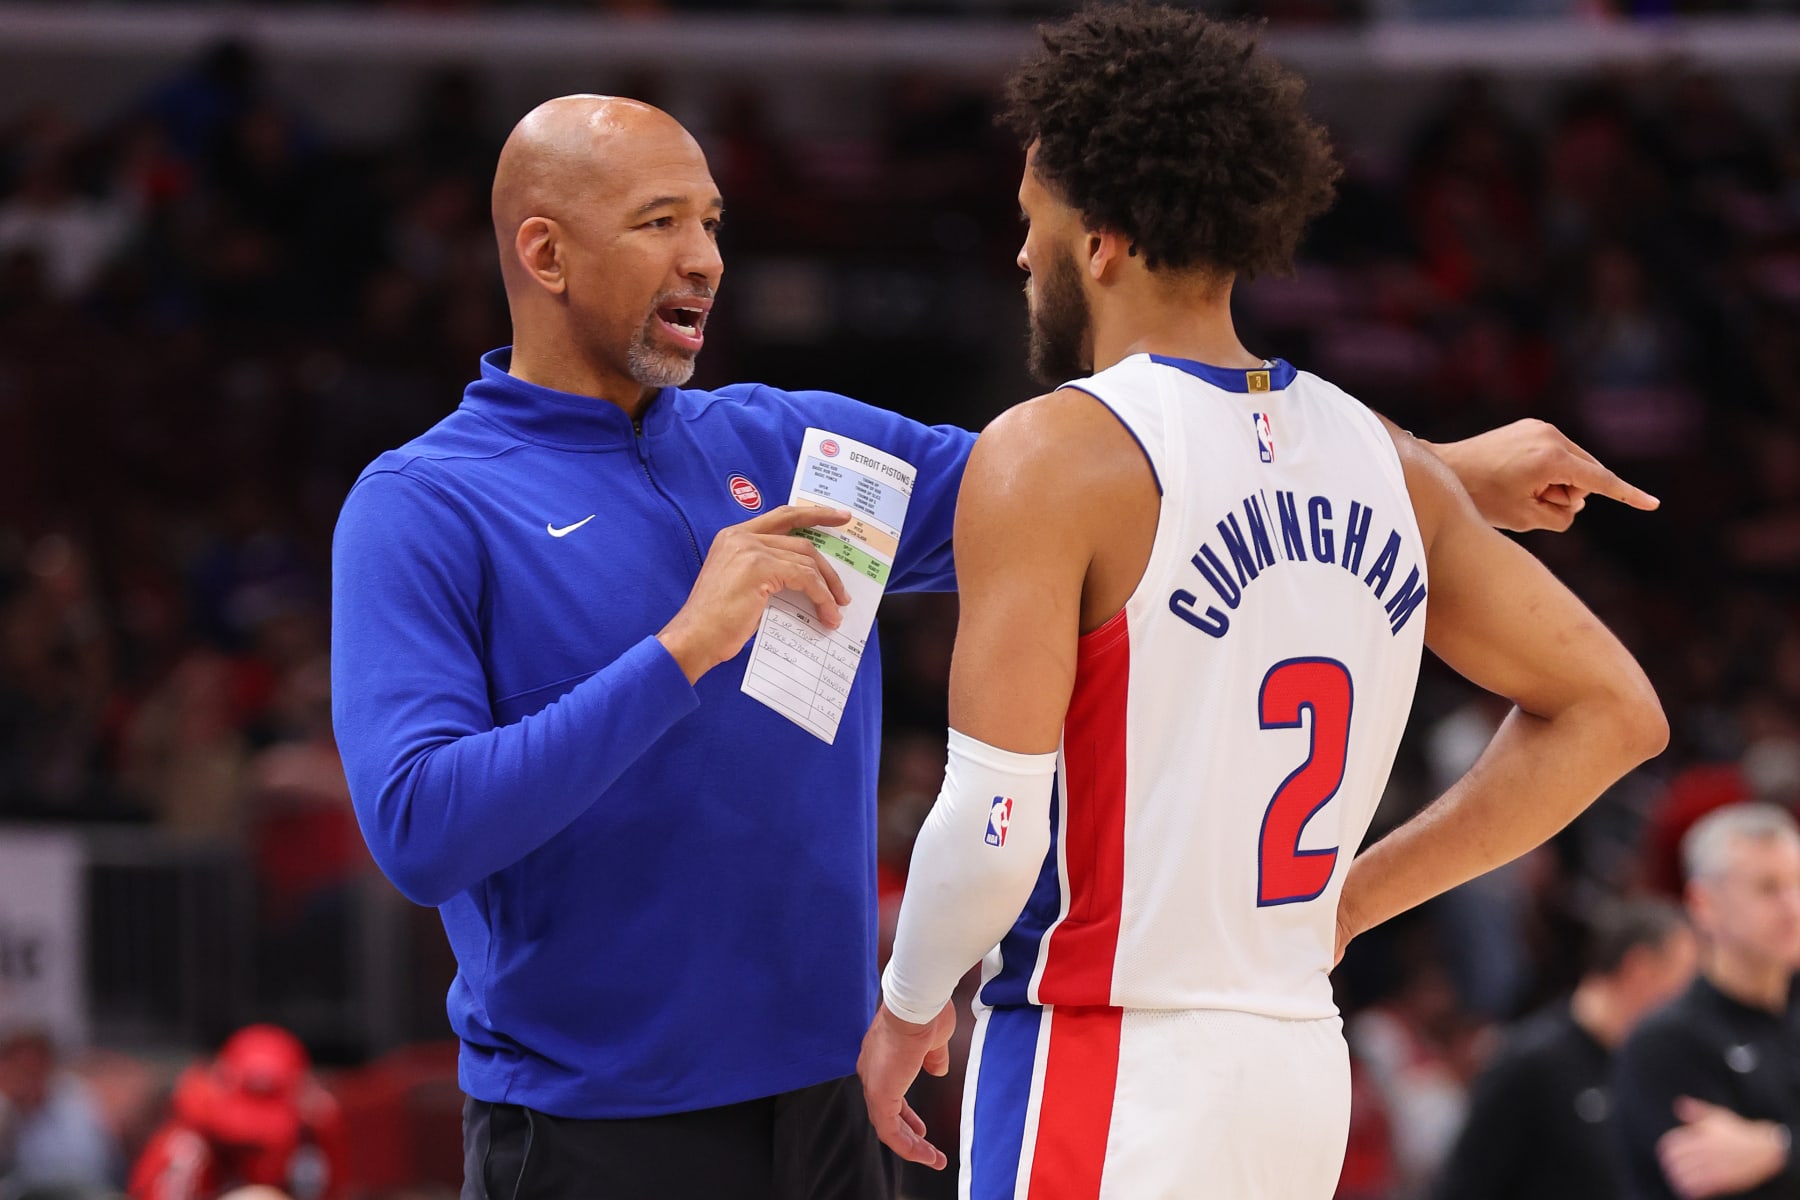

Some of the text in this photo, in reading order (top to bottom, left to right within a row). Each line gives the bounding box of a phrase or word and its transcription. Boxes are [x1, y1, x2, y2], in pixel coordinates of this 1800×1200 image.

[850, 452, 880, 470] DETROIT
[881, 464, 910, 486] PISTONS
[1168, 489, 1427, 638] CUNNNGHAM
[1257, 656, 1354, 908] 2
